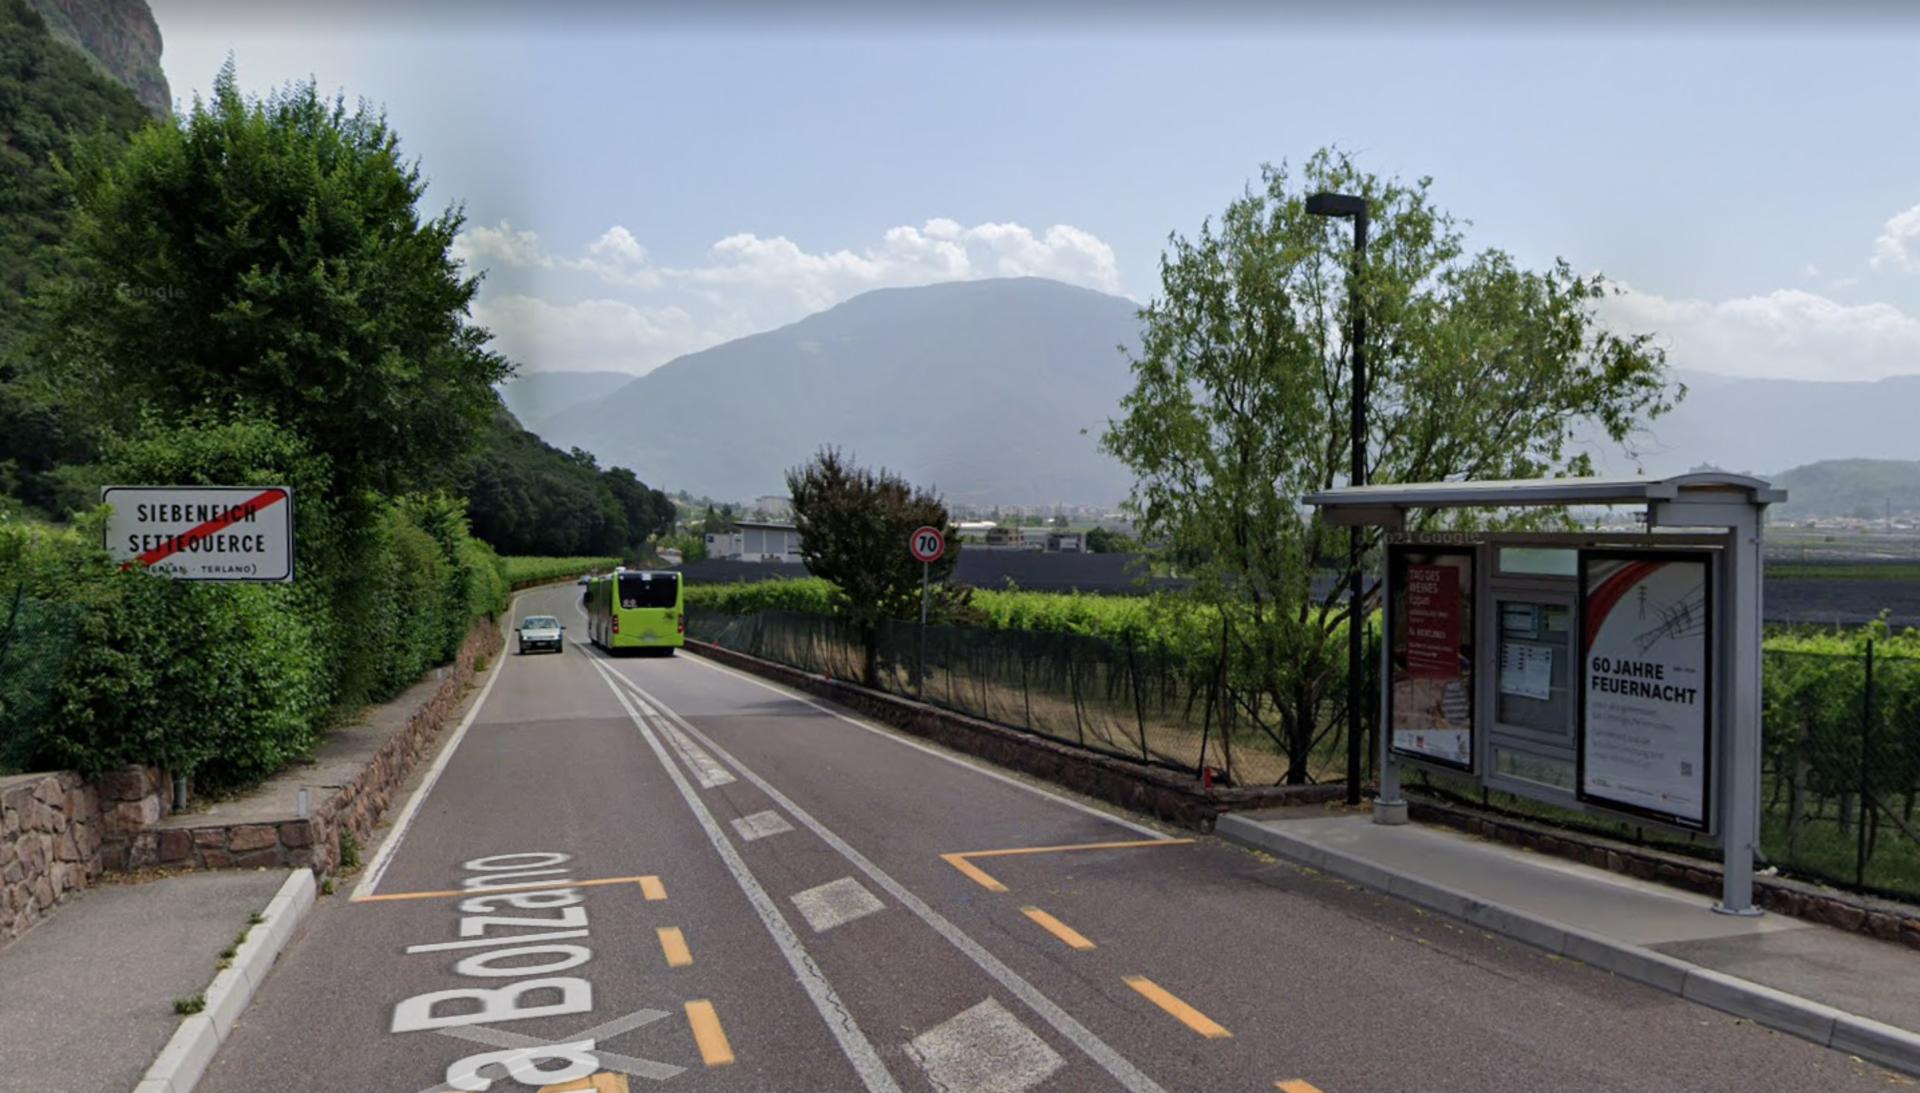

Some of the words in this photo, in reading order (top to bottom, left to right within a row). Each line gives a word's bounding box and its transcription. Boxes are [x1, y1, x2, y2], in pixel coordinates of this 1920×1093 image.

[137, 504, 257, 522] SIEBENEICH
[919, 536, 938, 552] 70
[1592, 656, 1611, 673] 60
[1613, 660, 1664, 680] JAHRE
[1592, 676, 1697, 705] FEUERNACHT
